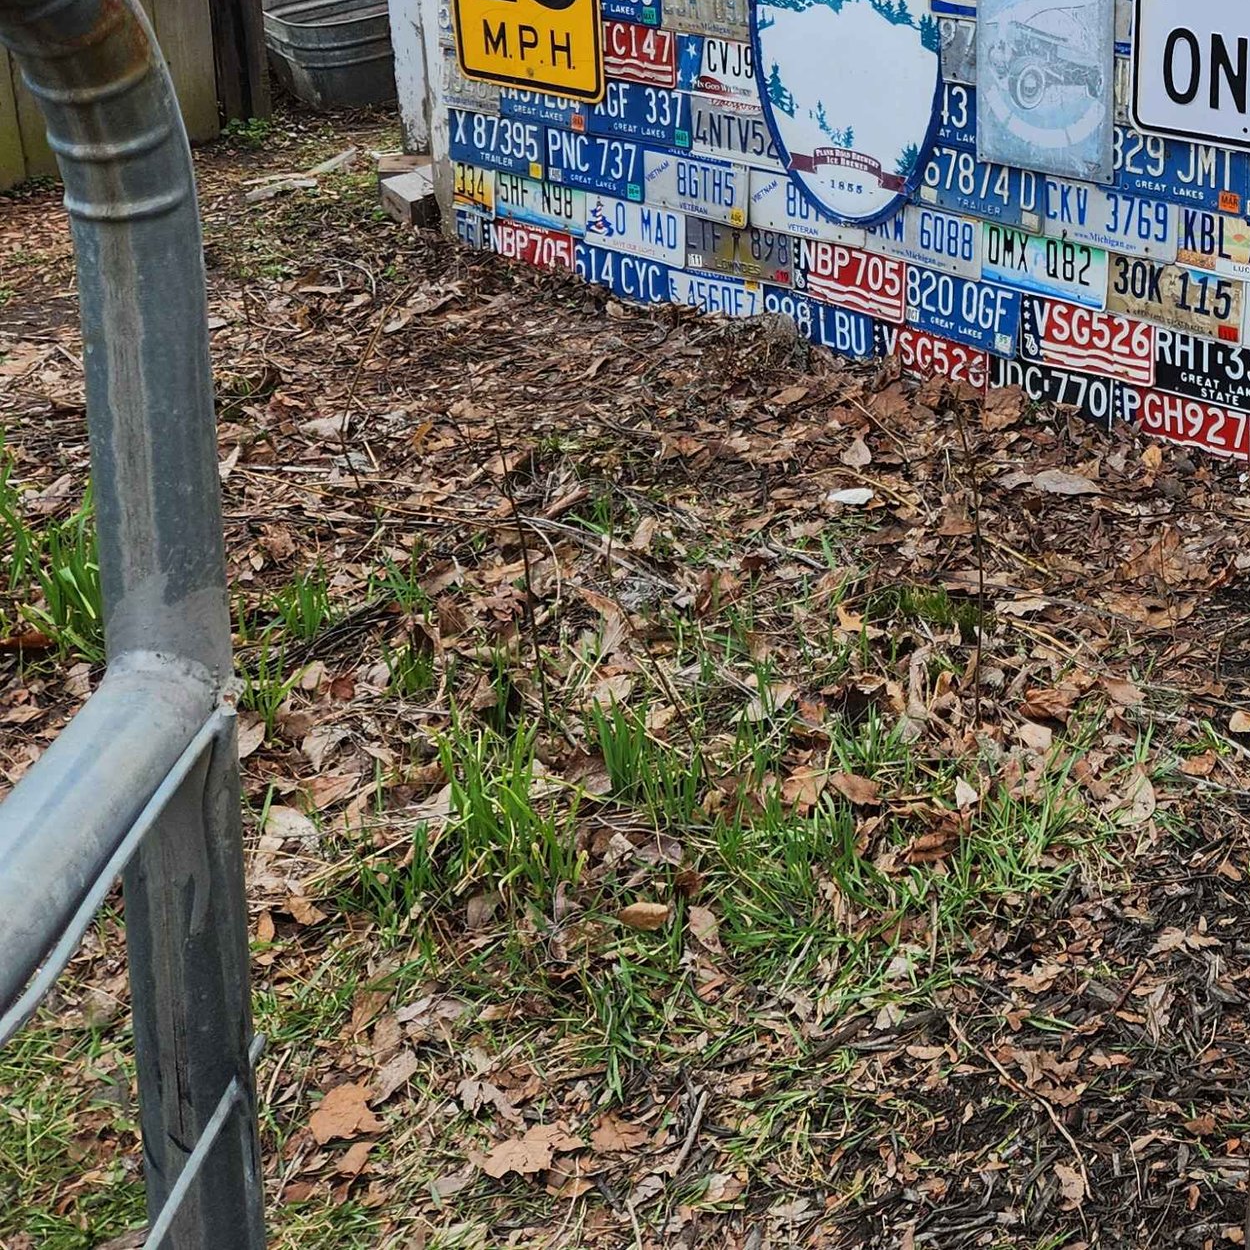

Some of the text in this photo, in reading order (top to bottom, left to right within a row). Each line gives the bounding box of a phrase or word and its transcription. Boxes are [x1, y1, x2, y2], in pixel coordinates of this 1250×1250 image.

[611, 4, 635, 16] LAKES
[483, 19, 576, 70] M.P.H.
[645, 88, 683, 128] 337
[455, 111, 537, 161] X 87395
[614, 123, 666, 139] GREAT LAKES
[480, 152, 513, 167] TRAILER
[547, 128, 637, 182] PNC 737
[646, 160, 670, 182] VIETNAM
[542, 182, 572, 219] N98
[570, 174, 616, 190] GREAT LAKES
[677, 162, 736, 208] 8GTH5
[1135, 180, 1204, 200] GREAT LAKES
[679, 202, 708, 216] VETERAN
[957, 197, 1001, 216] TRAILER
[1045, 180, 1168, 243] CKV 3769
[641, 206, 676, 249] MAD
[787, 223, 819, 236] VETERAN
[921, 212, 974, 262] 6088
[1184, 209, 1232, 260] KBL
[1046, 238, 1091, 286] Q82
[906, 267, 1013, 332] 820 QGF
[1114, 257, 1232, 320] 30K 115
[819, 305, 866, 355] LBU
[930, 316, 982, 340] GREAT LAKES
[1034, 299, 1151, 358] VSG526
[1180, 371, 1220, 389] GREAT
[1200, 387, 1239, 406] STATE
[1124, 387, 1248, 449] PGH927
